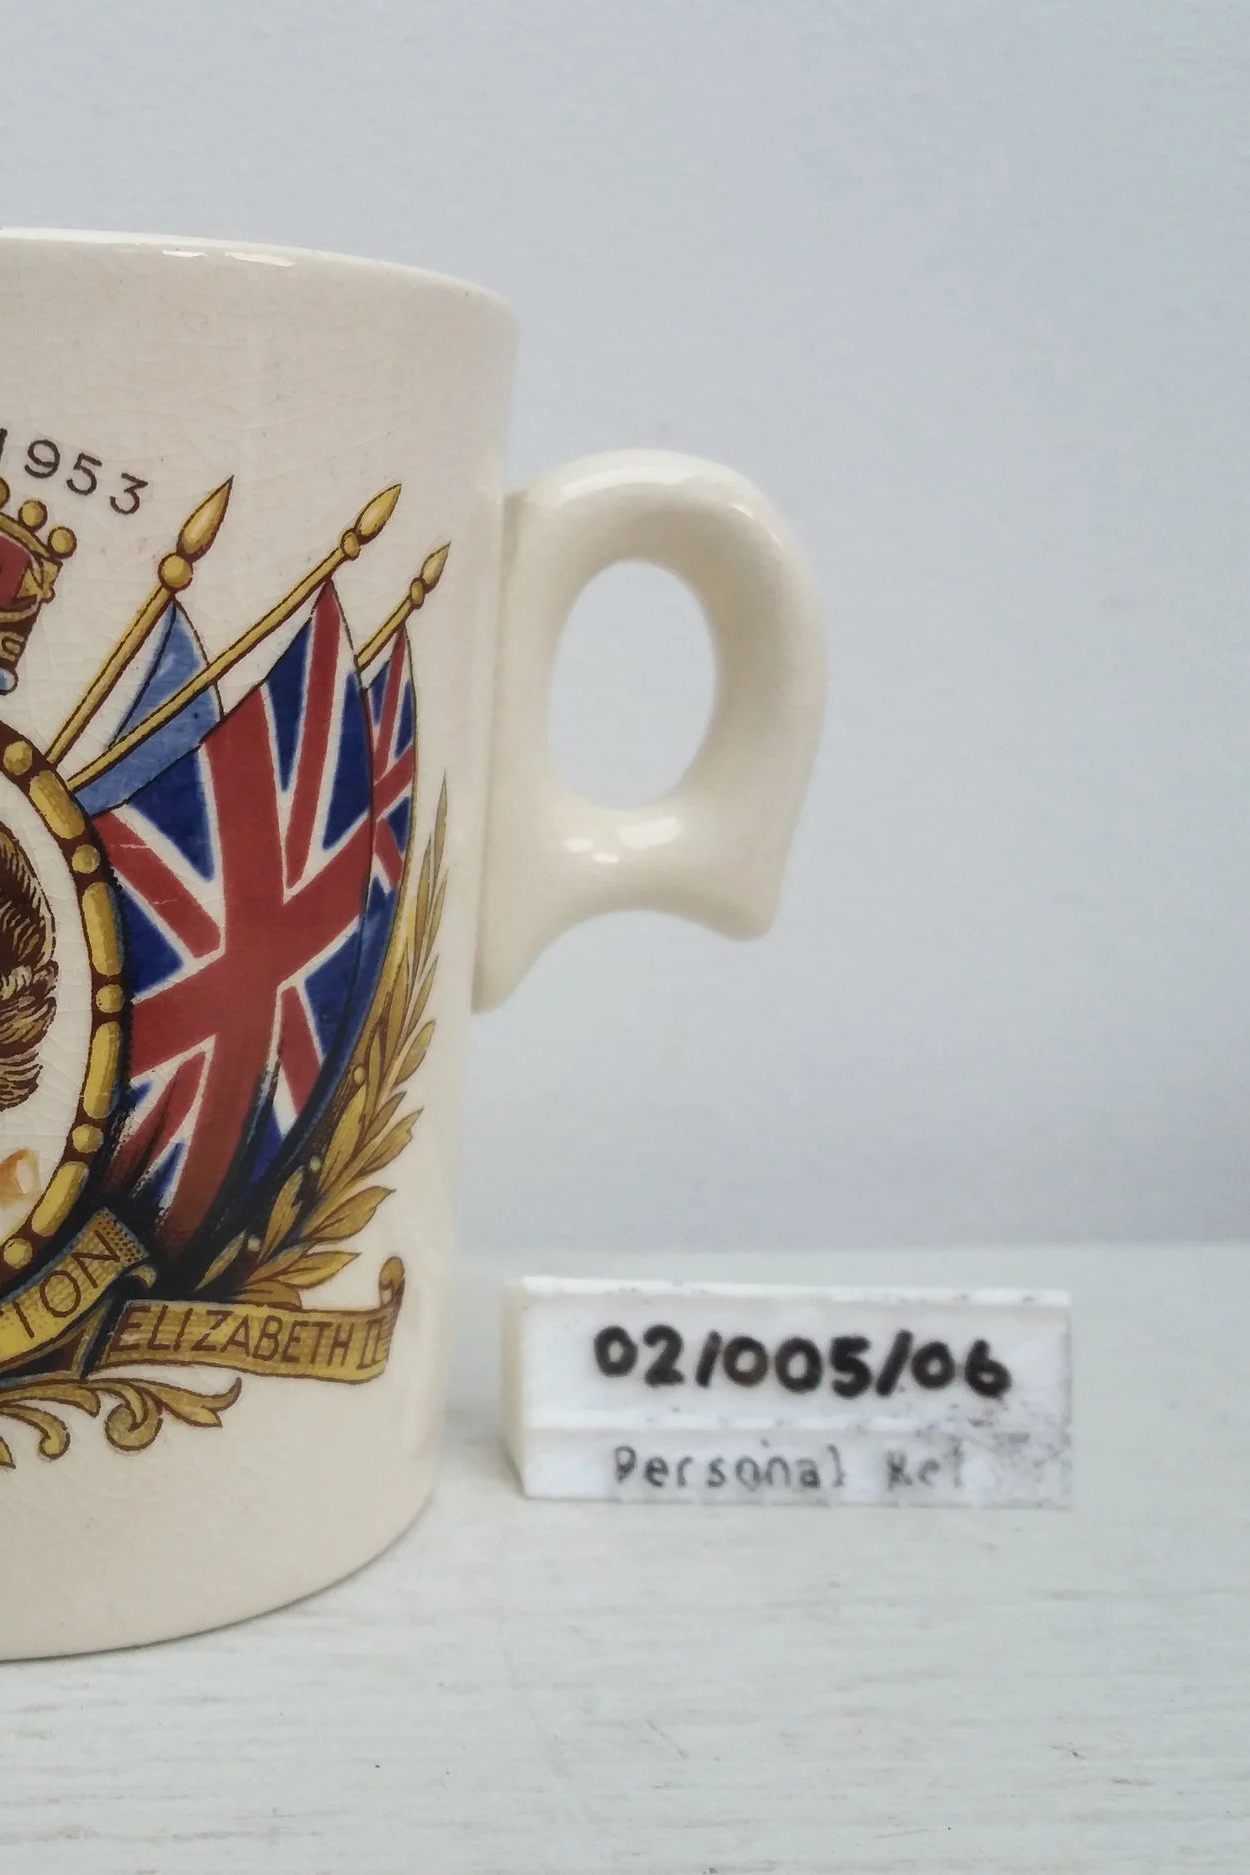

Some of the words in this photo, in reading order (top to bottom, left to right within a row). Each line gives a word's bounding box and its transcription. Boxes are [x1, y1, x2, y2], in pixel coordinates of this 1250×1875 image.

[111, 1303, 356, 1369] ELIZABETH
[593, 1324, 1013, 1400] 02/005/06
[612, 1443, 847, 1493] Personal
